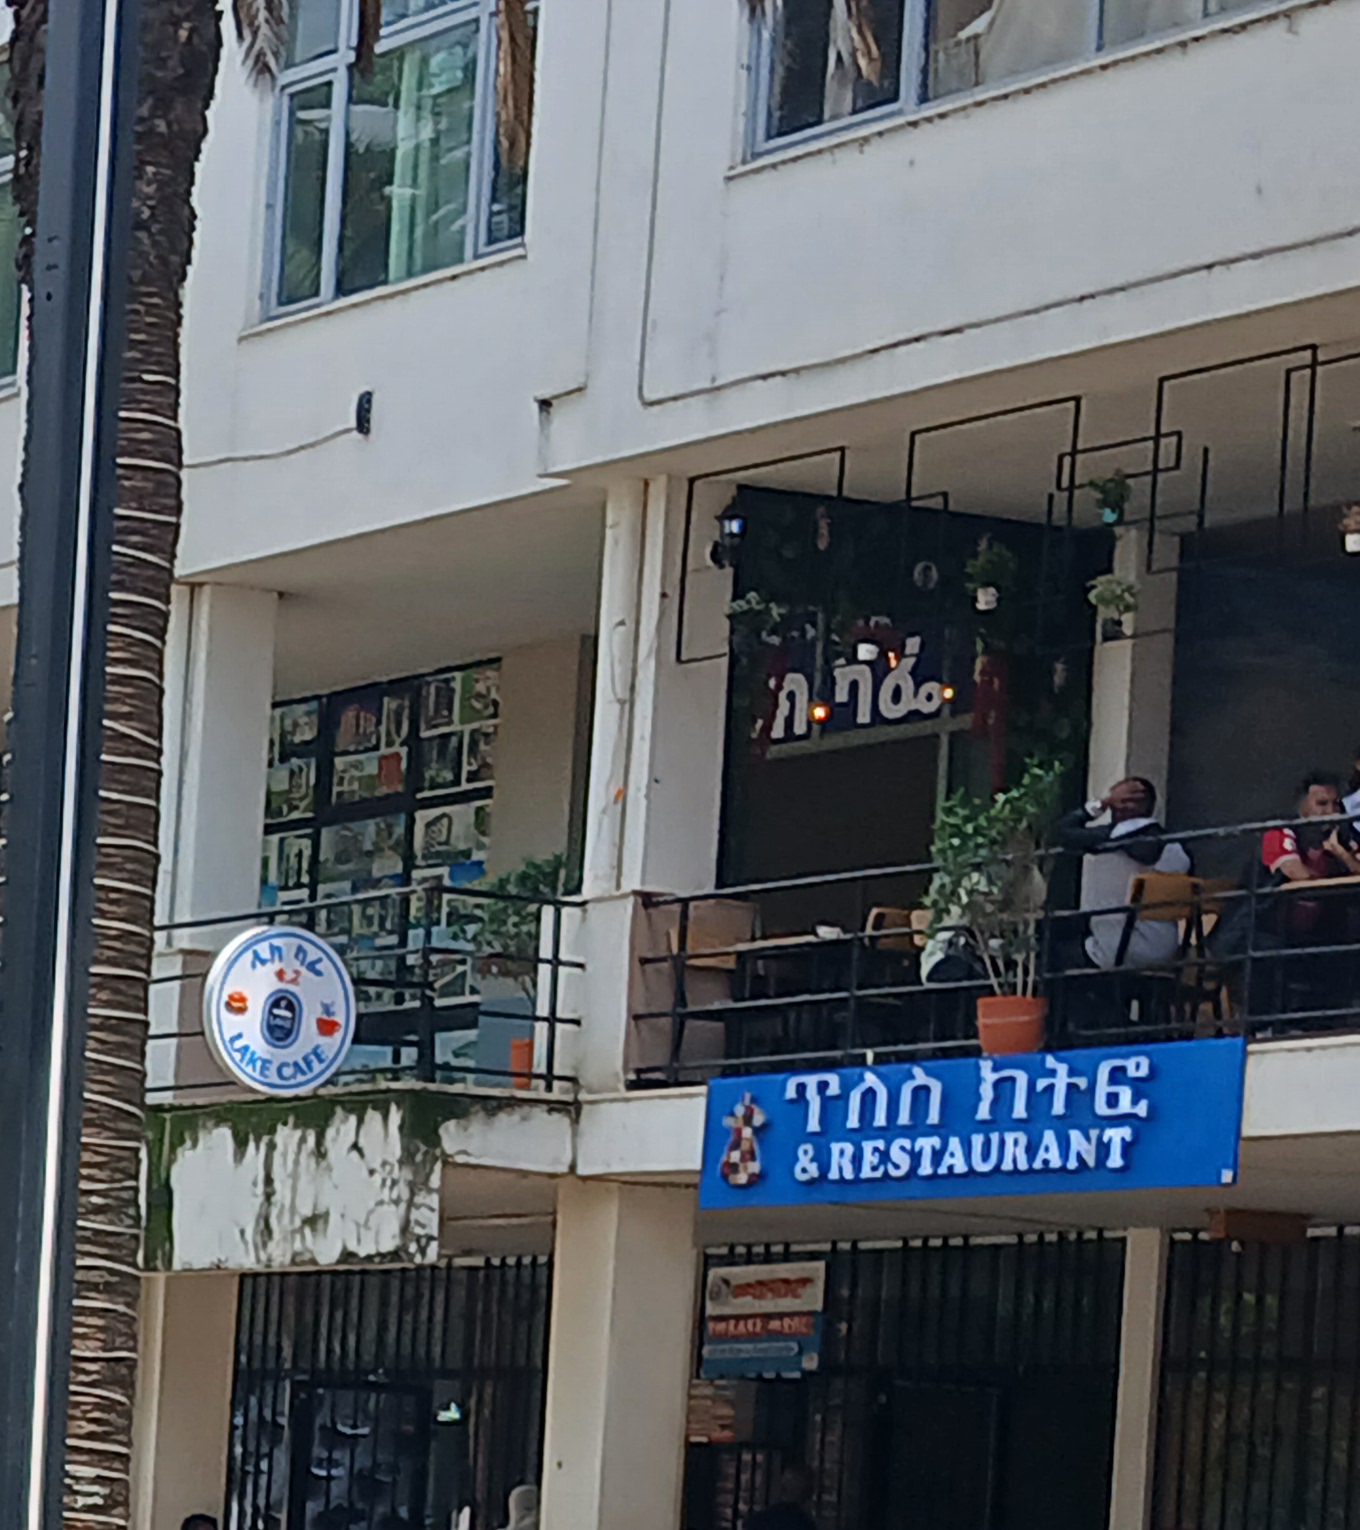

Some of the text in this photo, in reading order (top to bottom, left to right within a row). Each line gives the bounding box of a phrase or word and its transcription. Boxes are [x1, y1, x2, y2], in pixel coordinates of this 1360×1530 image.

[228, 1032, 329, 1081] LAKE CAFE
[975, 1054, 1150, 1120] ክትፎ
[827, 1125, 1132, 1181] RESTAURANT
